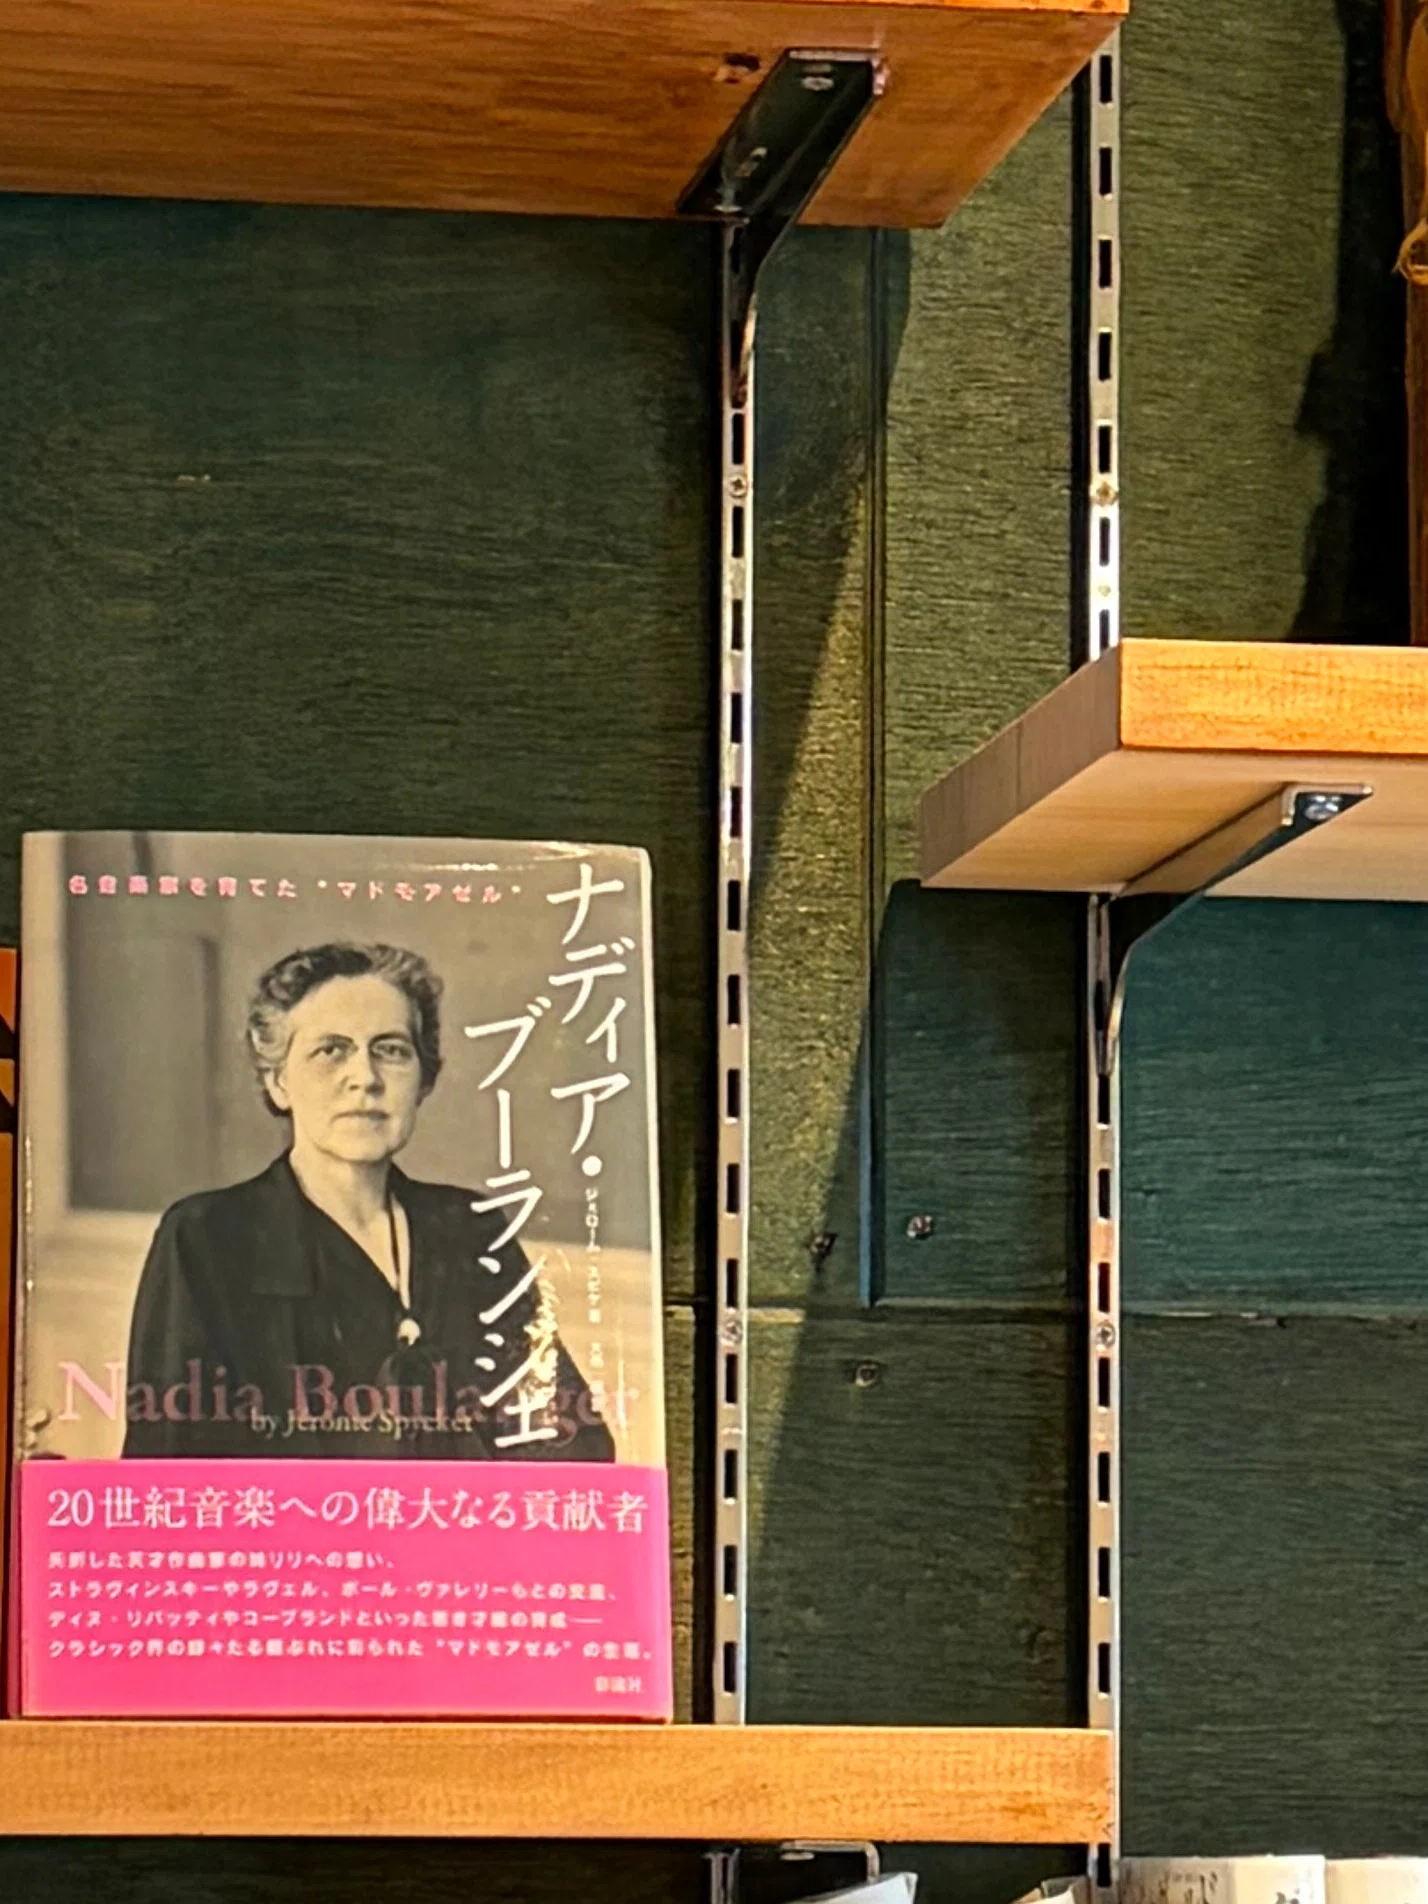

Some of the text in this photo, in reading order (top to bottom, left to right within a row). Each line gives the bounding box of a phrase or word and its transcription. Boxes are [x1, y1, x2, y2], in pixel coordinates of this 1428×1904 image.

[462, 996, 560, 1451] ブーランジェ
[57, 1358, 266, 1424] Nadia
[288, 1359, 638, 1442] Boulager
[249, 1407, 279, 1438] by
[47, 1484, 649, 1534] 20世紀音楽への偉大なる貢献者
